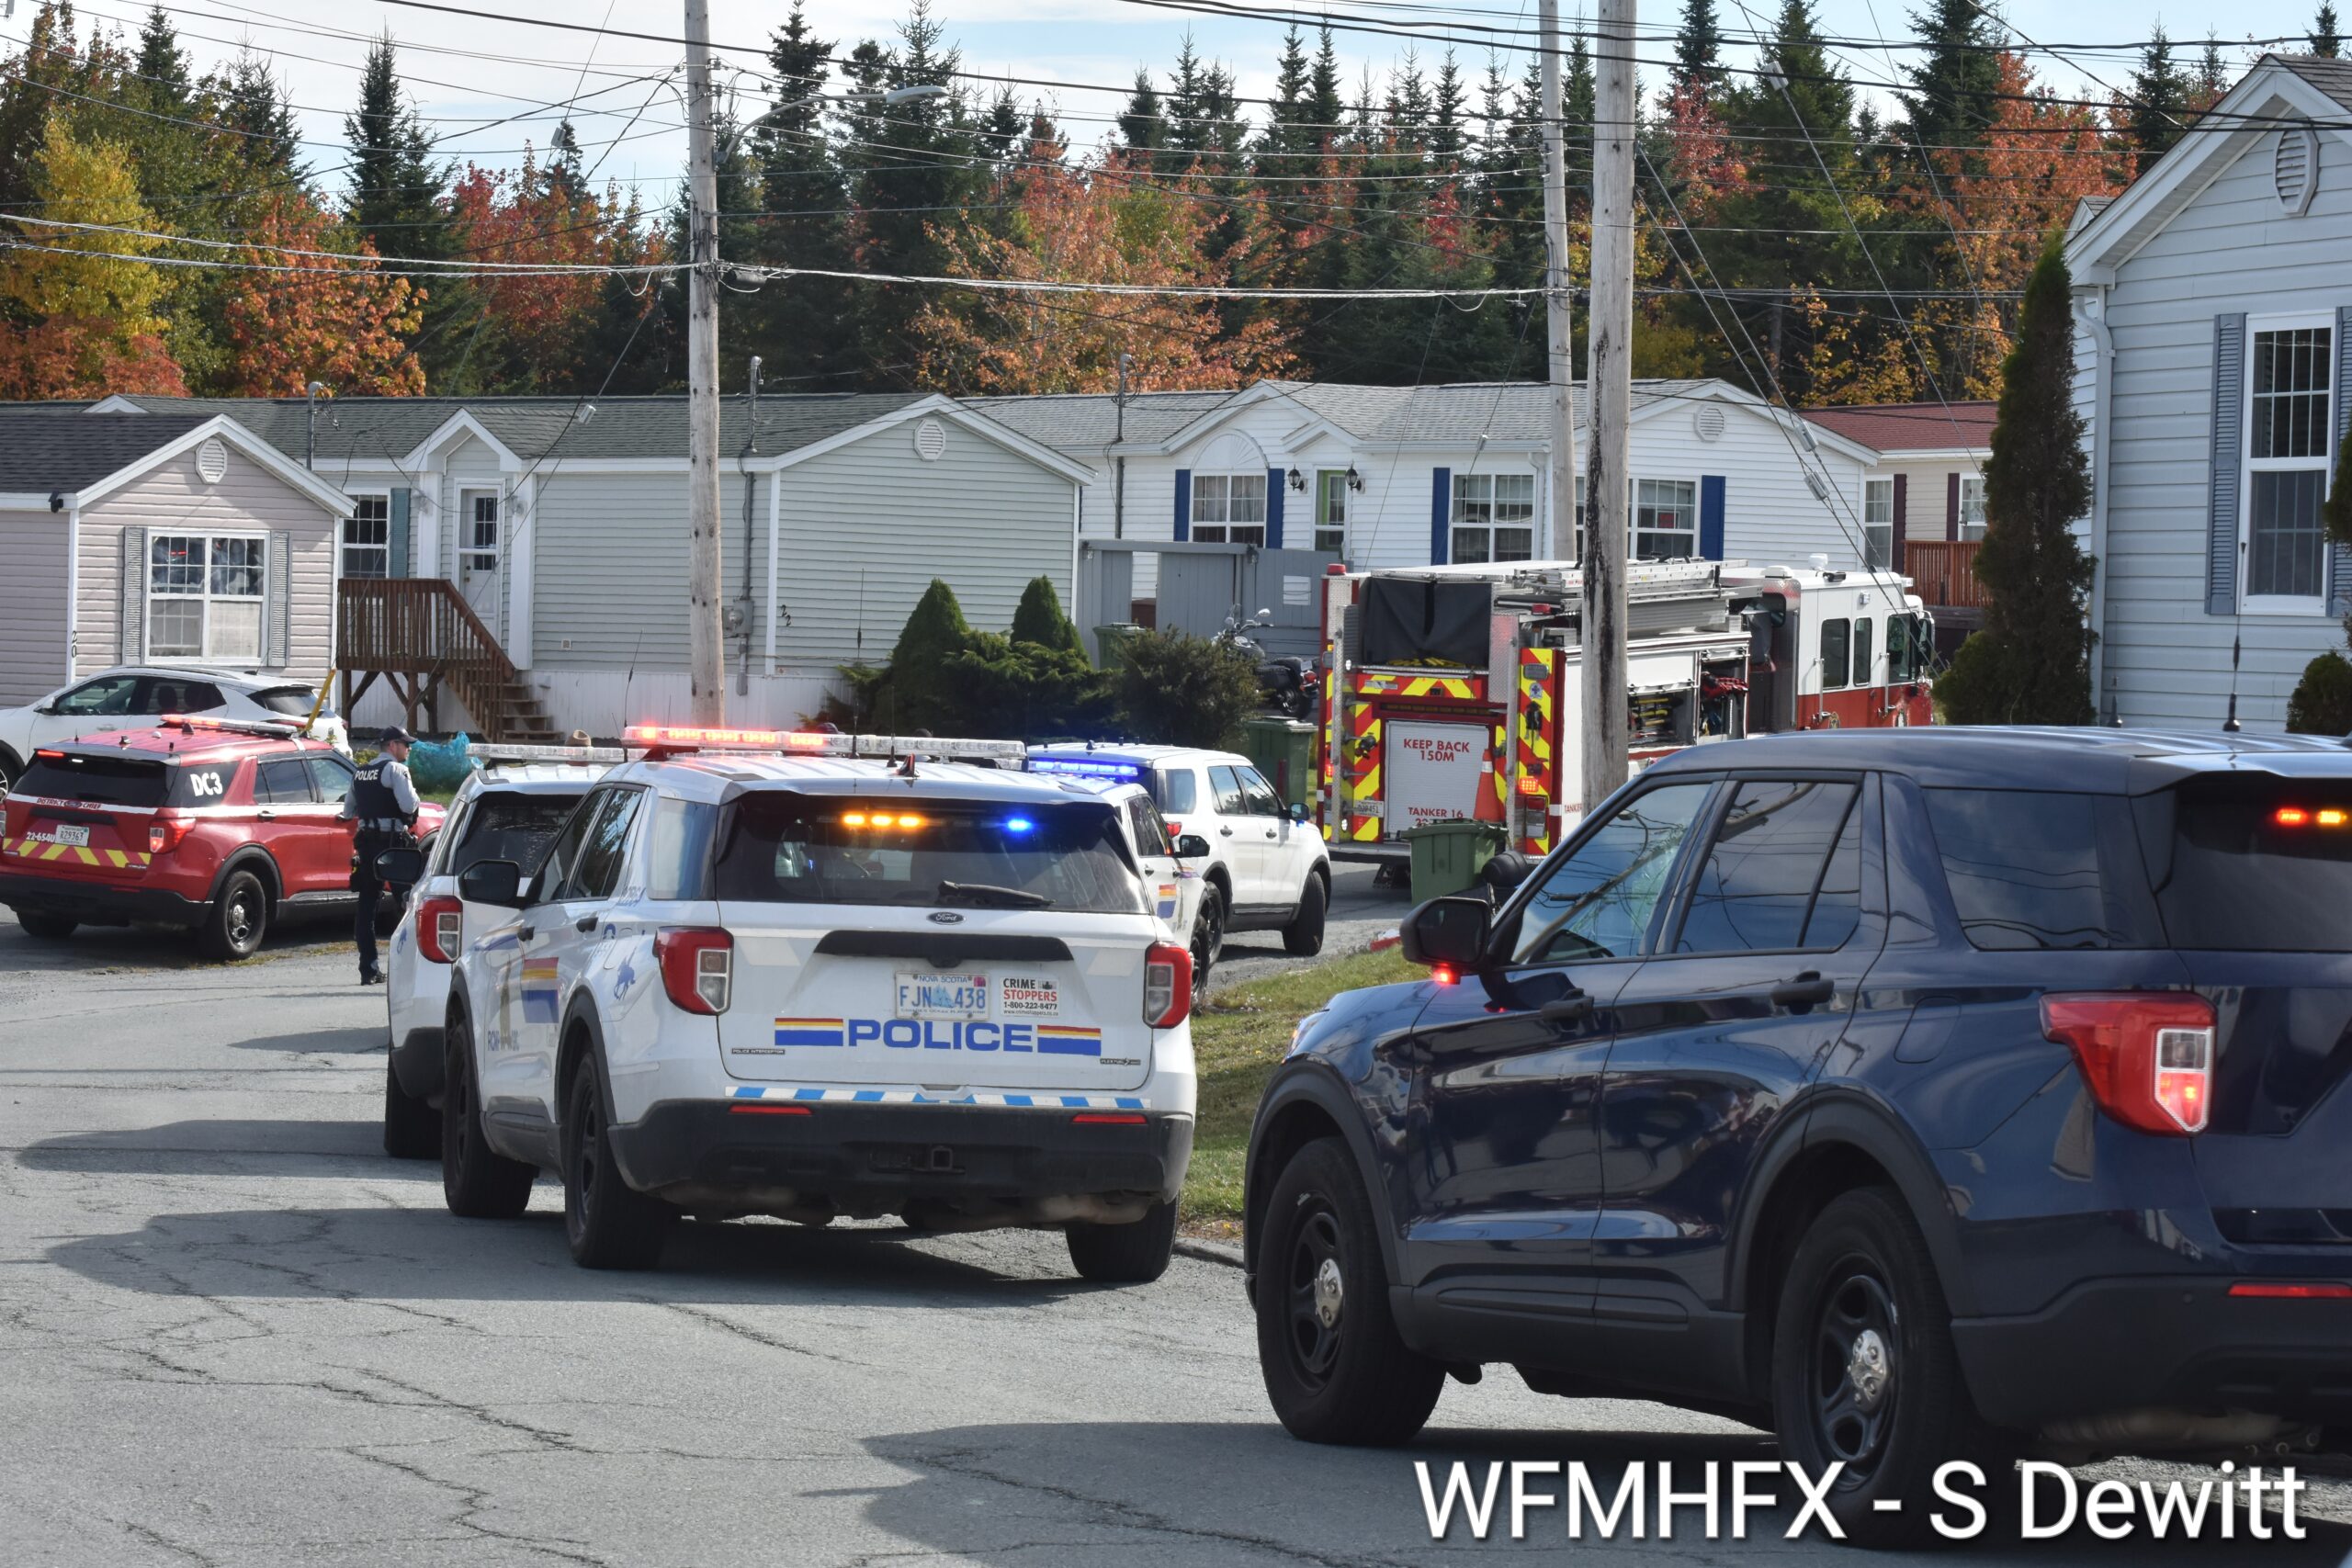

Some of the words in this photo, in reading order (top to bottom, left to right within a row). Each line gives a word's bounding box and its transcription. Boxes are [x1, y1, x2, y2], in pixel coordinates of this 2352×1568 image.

[781, 604, 792, 626] 22
[72, 630, 77, 658] 20
[1404, 739, 1433, 750] KEEP
[1437, 740, 1470, 753] BACK
[1420, 750, 1454, 761] 150M
[355, 769, 379, 781] POLICE
[189, 772, 223, 796] DC3
[37, 797, 63, 806] DISTRICT
[1408, 807, 1447, 818] TANKER
[1452, 809, 1464, 818] 16
[1003, 978, 1035, 989] CRIME
[899, 986, 932, 1008] FJN
[955, 987, 986, 1010] 438
[1003, 989, 1057, 1002] STOPPERS
[1003, 1001, 1057, 1010] 1-800-222-8477
[848, 1019, 1033, 1053] POLICE
